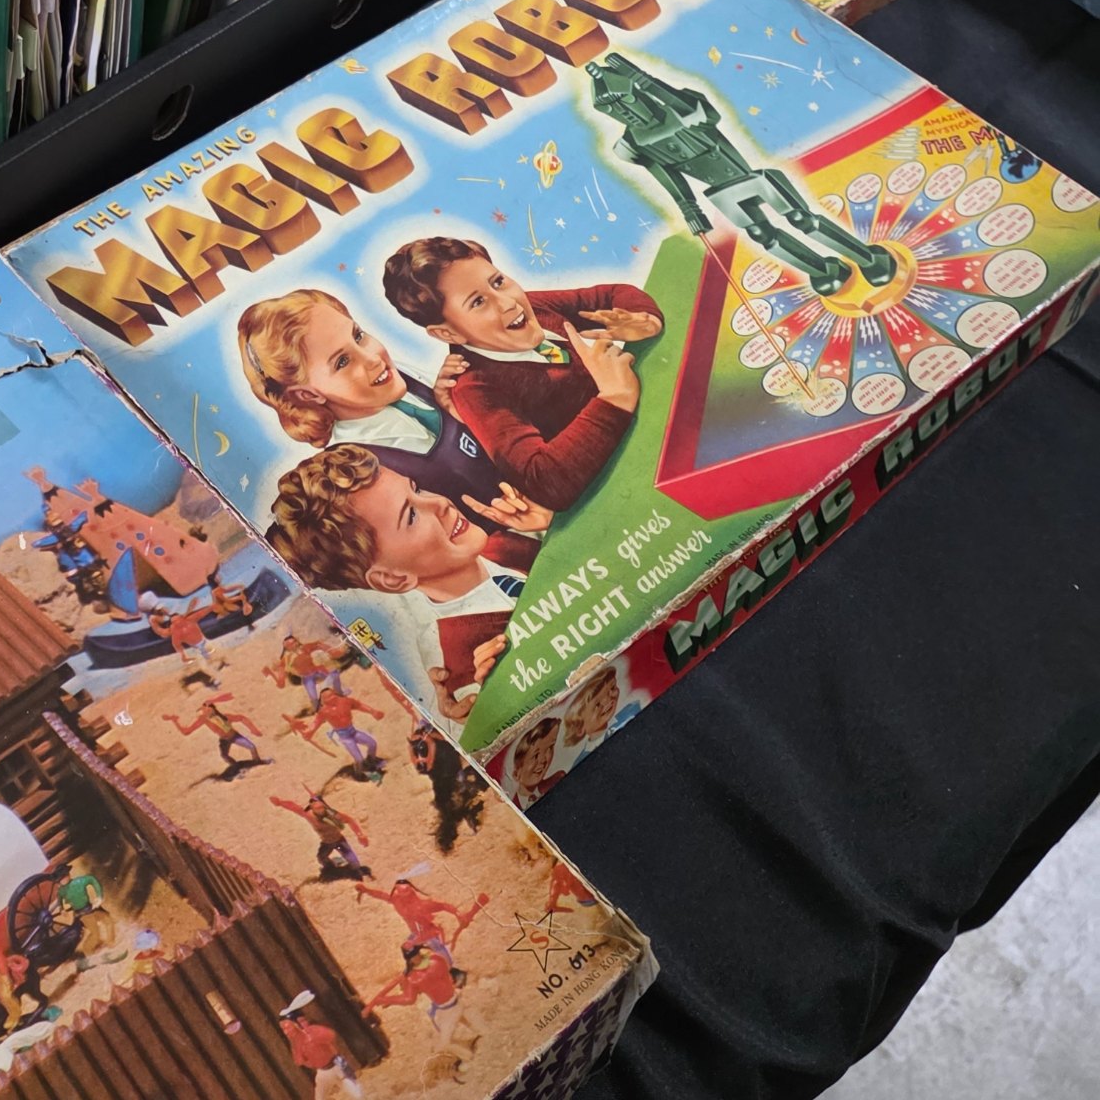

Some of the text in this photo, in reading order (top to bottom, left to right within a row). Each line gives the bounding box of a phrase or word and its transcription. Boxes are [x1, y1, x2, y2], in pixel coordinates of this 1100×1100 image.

[72, 124, 258, 238] THE AMAZING
[920, 133, 967, 156] THE
[45, 106, 416, 348] MAGIC
[662, 316, 1052, 676] MAGIC ROBOT
[704, 511, 775, 568] MADE IN ENGLAND
[505, 508, 672, 649] ALWAYS gives
[509, 526, 713, 694] the RIGHT answer
[529, 930, 550, 949] S
[535, 943, 597, 1000] NO. 613
[533, 1006, 564, 1033] MADE
[562, 995, 576, 1008] IN
[573, 970, 601, 997] HONG
